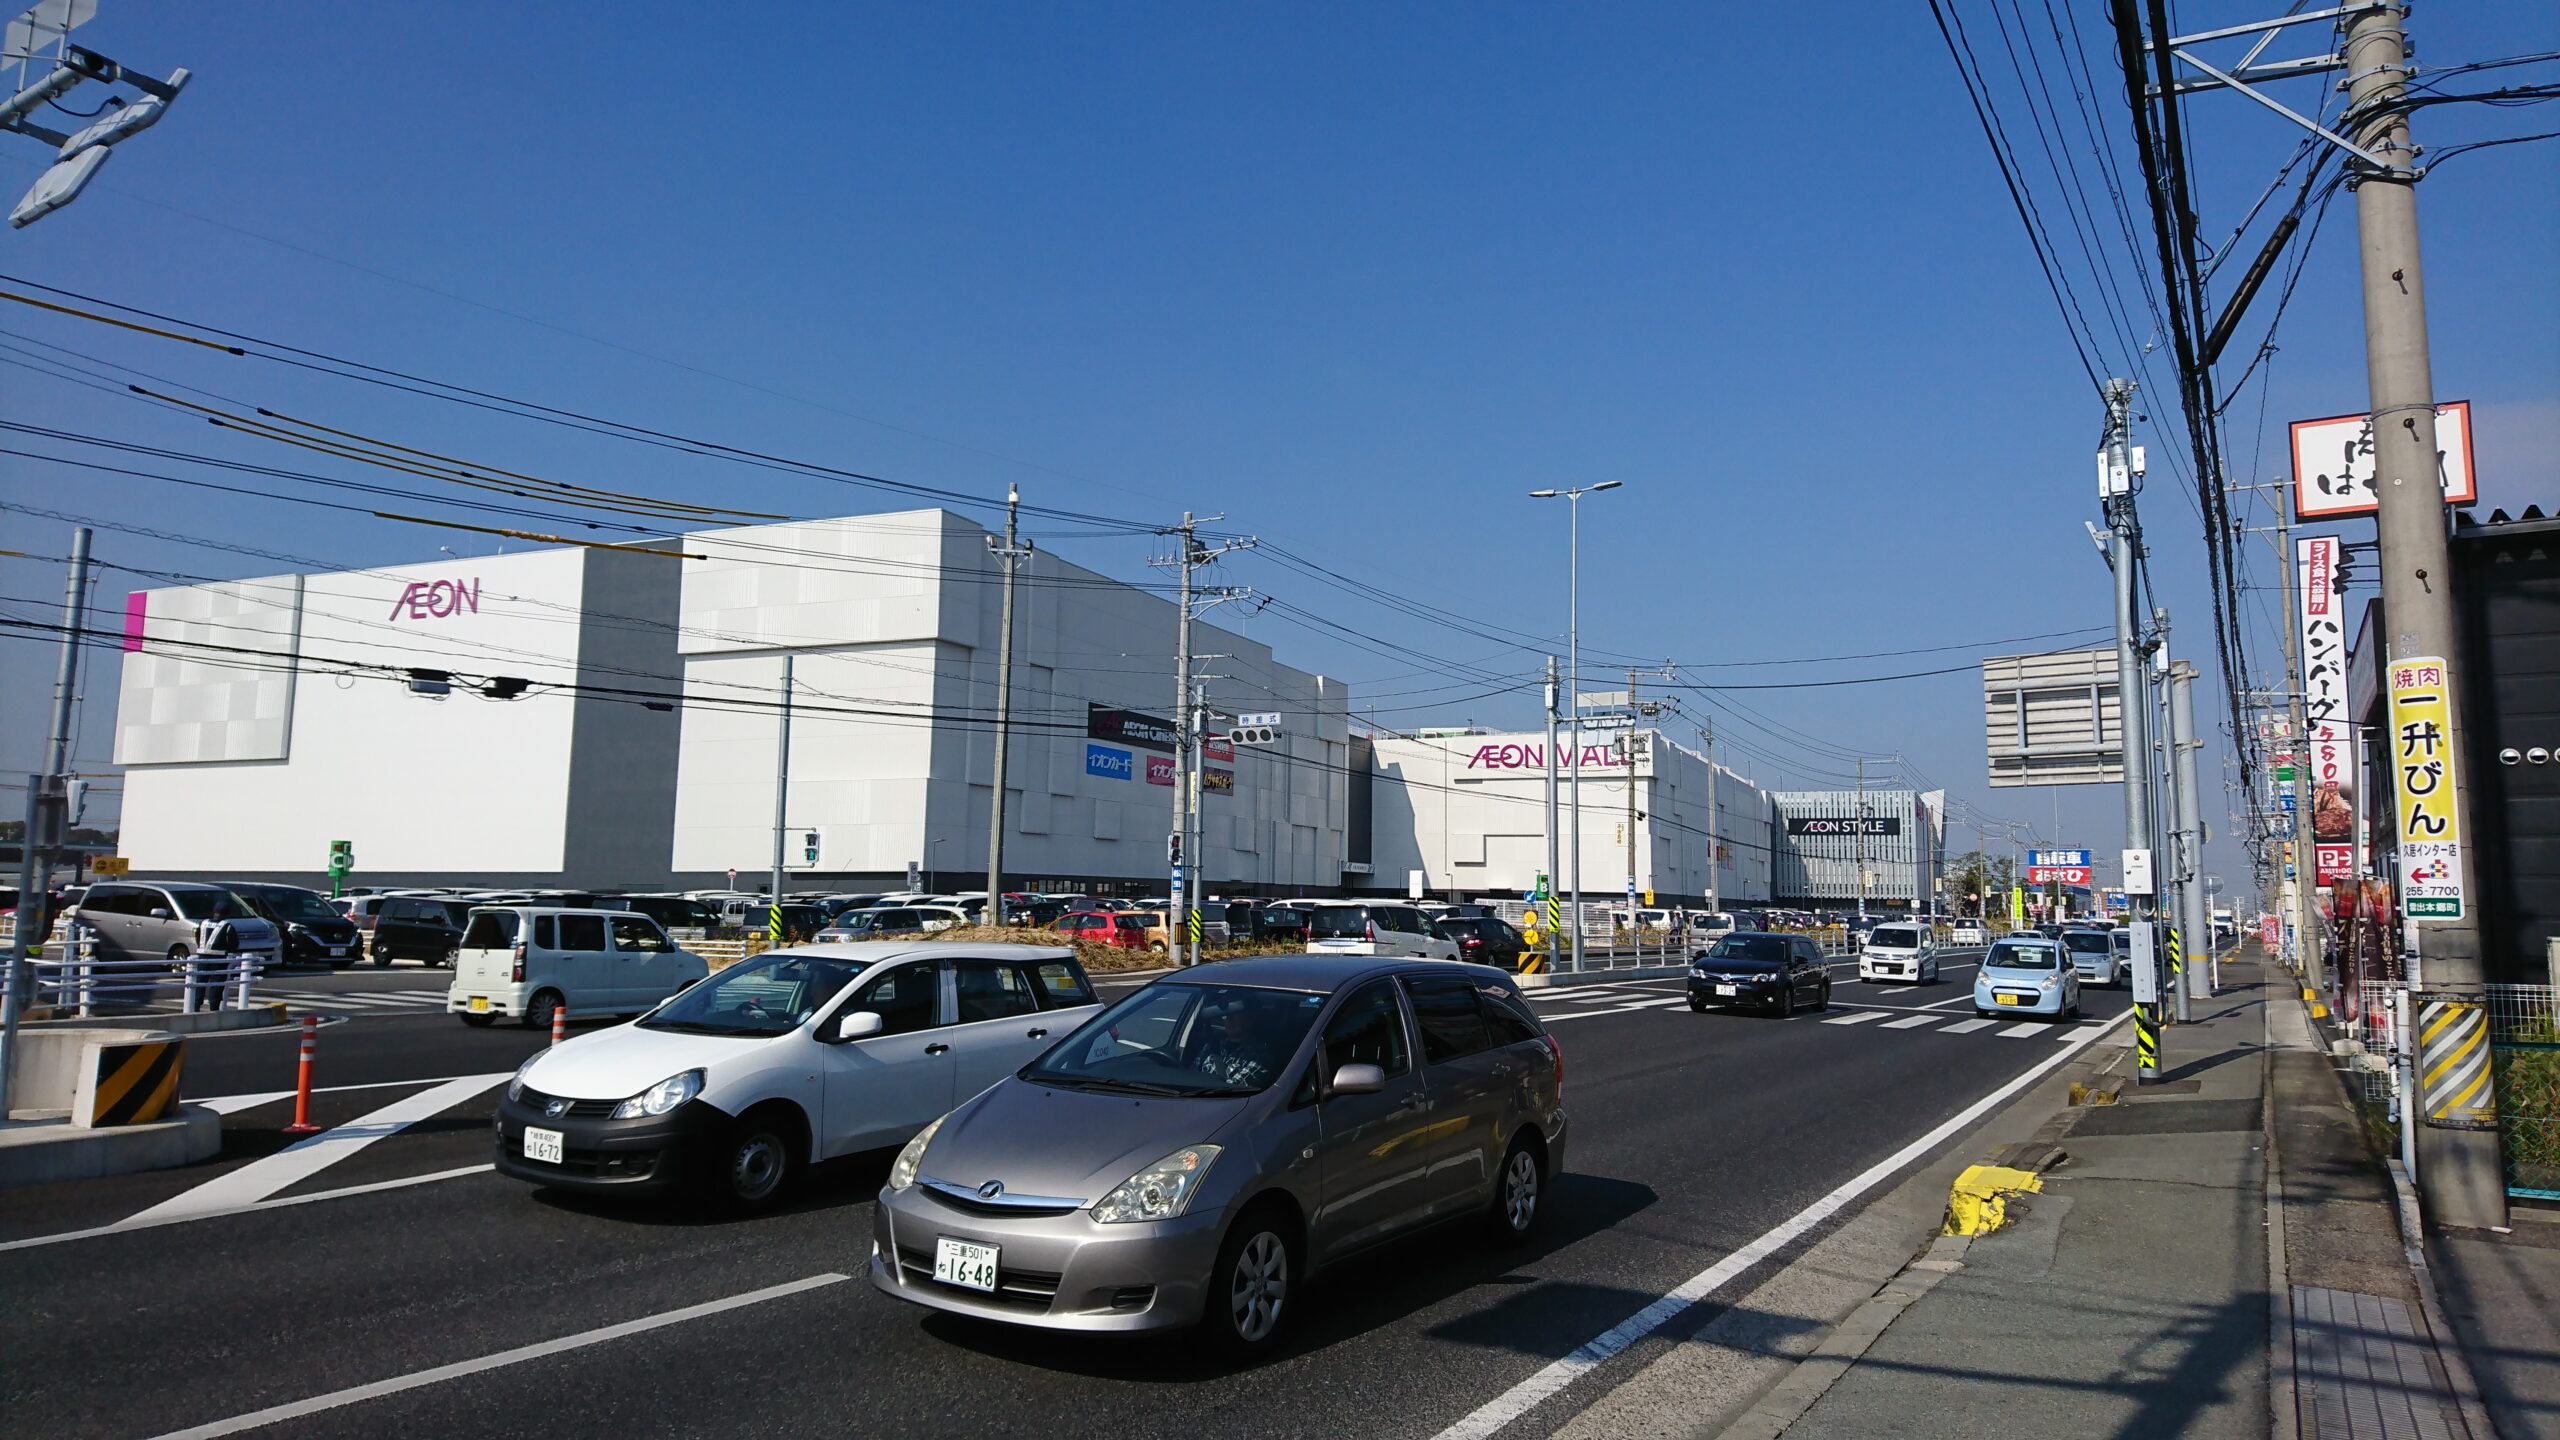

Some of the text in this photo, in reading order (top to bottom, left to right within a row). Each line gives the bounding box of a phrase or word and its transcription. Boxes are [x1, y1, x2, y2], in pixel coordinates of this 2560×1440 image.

[2308, 620, 2340, 719] ハンバーグ
[2395, 667, 2440, 688] 焼肉
[1089, 754, 1132, 772] イオンカード
[2400, 696, 2446, 835] 一升びん
[1842, 821, 1884, 832] STYLE
[2403, 843, 2457, 857] 久居インター店
[2036, 851, 2082, 866] 自転車
[2322, 852, 2335, 865] P
[2035, 869, 2083, 882] あさひ
[2405, 886, 2460, 896] 255-7700
[533, 1142, 560, 1161] 16-72
[950, 1243, 984, 1259] 三重501
[950, 1258, 994, 1287] 16-48
